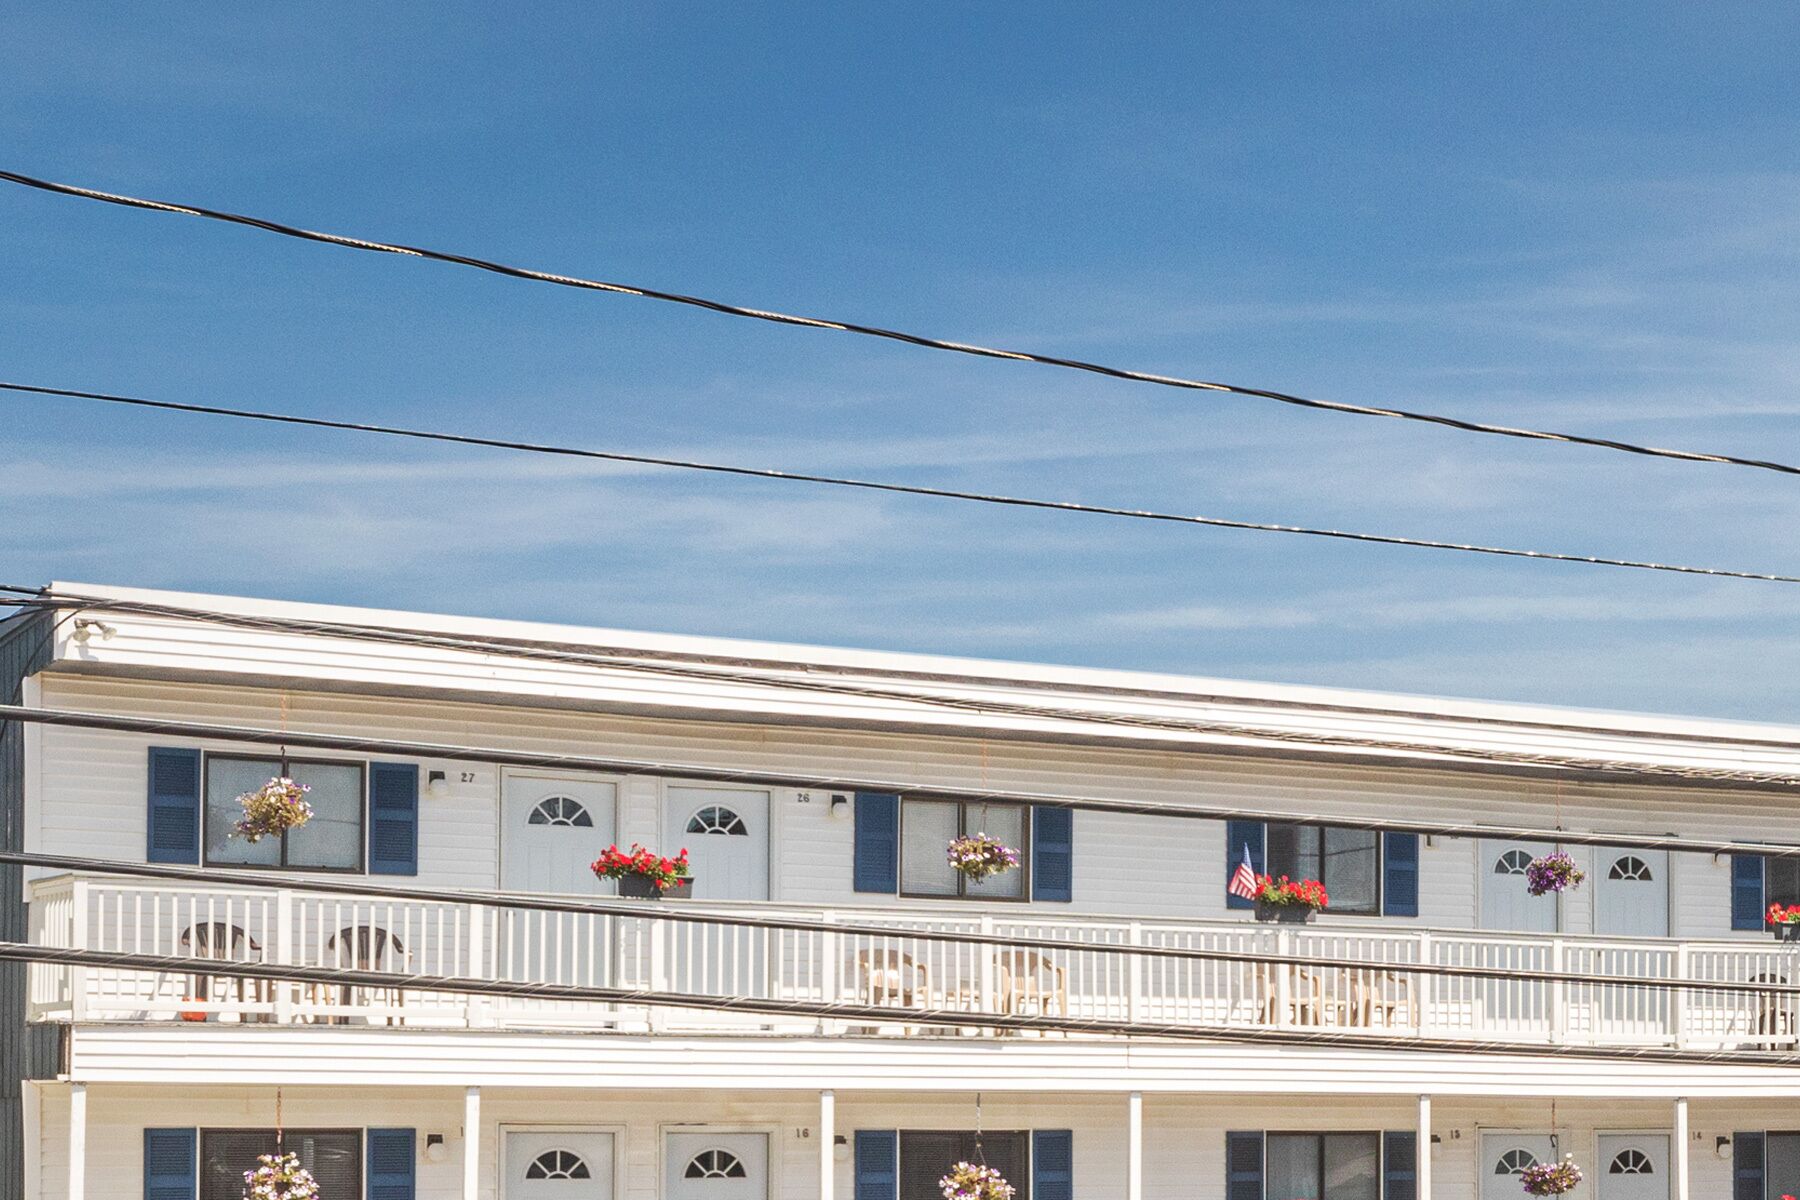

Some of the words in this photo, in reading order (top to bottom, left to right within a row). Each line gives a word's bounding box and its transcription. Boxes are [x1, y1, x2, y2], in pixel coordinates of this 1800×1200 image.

[461, 773, 475, 784] 27
[797, 793, 810, 803] 26
[796, 1128, 809, 1138] 16
